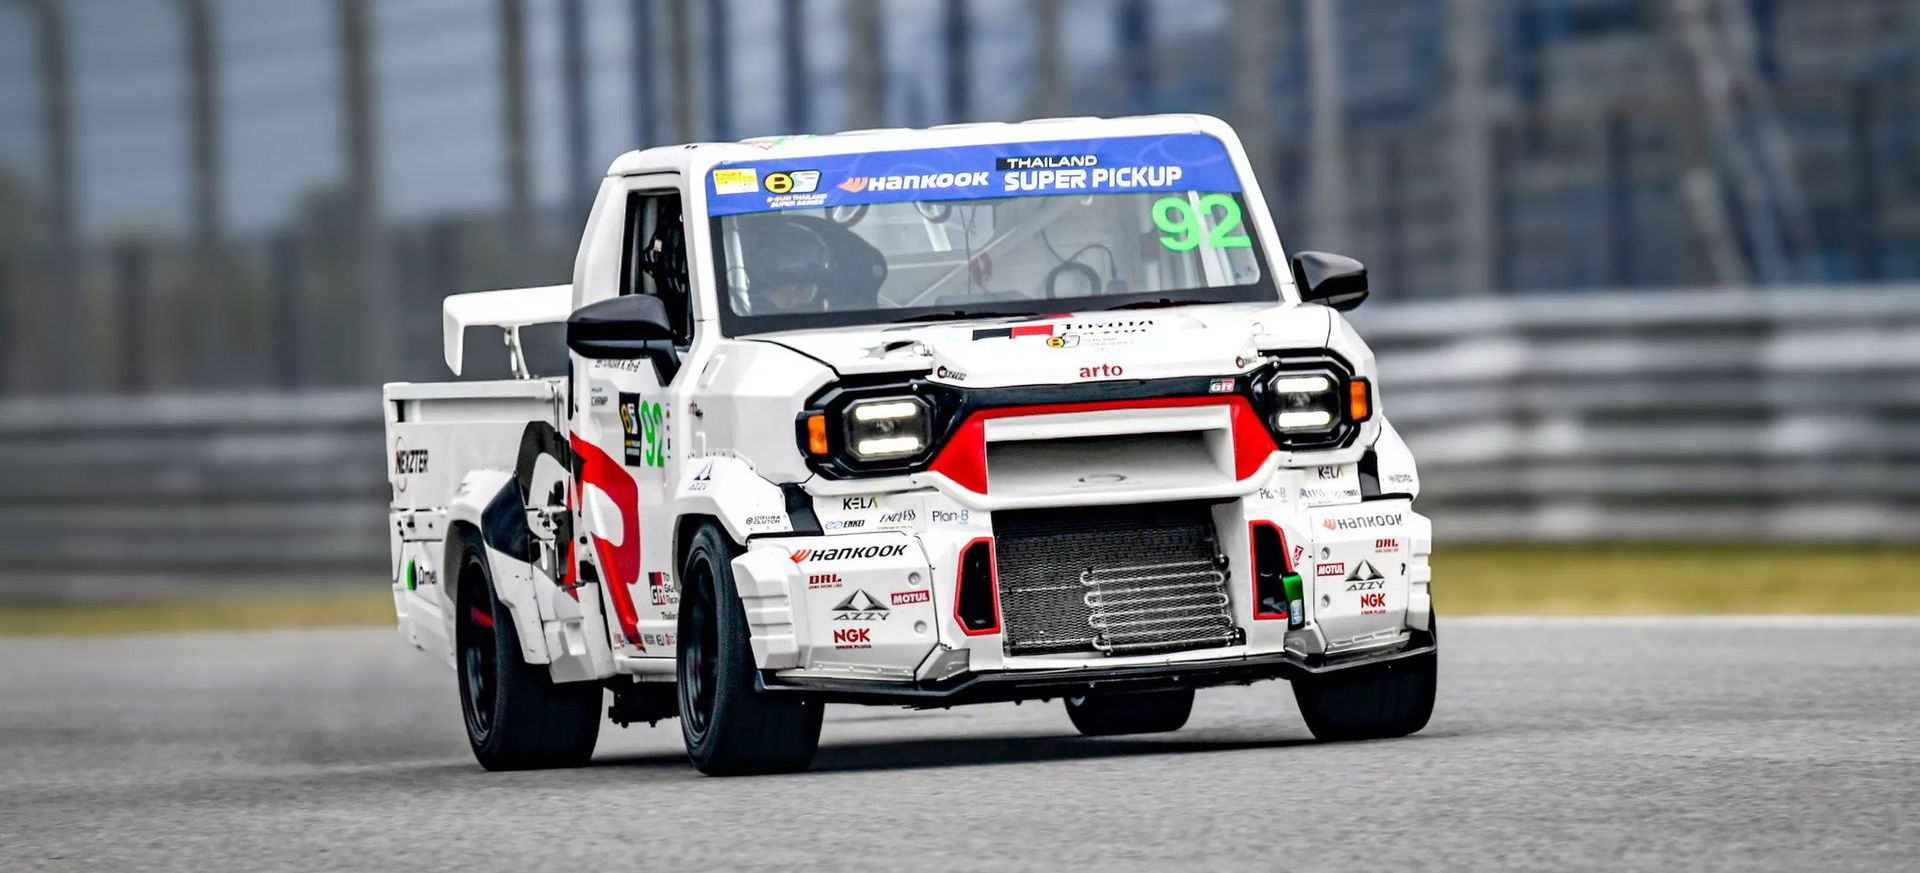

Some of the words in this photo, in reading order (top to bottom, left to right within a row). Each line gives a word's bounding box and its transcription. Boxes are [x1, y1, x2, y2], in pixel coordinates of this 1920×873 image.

[1007, 155, 1098, 169] THAILAND
[1004, 168, 1088, 192] SUPER
[1092, 166, 1182, 187] PICKUP
[1152, 194, 1252, 251] 92
[1079, 363, 1123, 378] arto
[640, 400, 665, 469] 92
[395, 450, 428, 473] NEXZTER
[843, 496, 878, 510] KELA
[1317, 564, 1344, 575] MOTUL
[1346, 581, 1385, 592] AZZY
[650, 585, 666, 606] GR
[892, 593, 929, 604] MOTUL
[1361, 593, 1386, 608] NGK
[832, 612, 891, 621] AZZY
[833, 628, 870, 644] NGK
